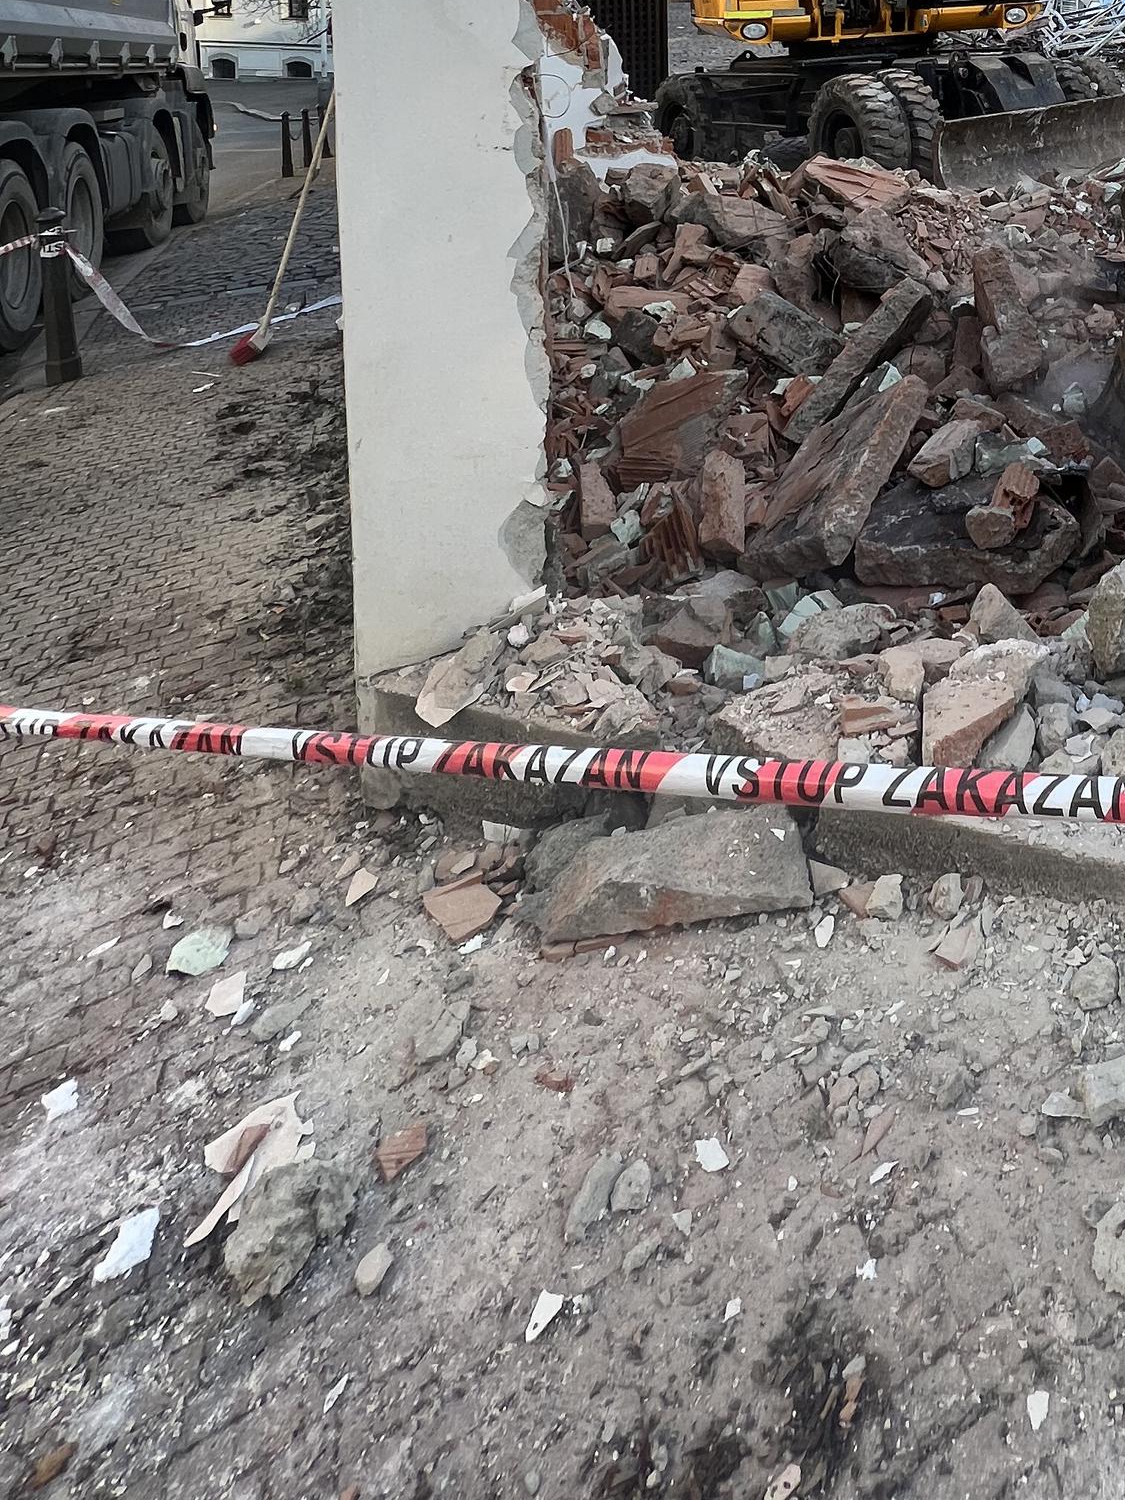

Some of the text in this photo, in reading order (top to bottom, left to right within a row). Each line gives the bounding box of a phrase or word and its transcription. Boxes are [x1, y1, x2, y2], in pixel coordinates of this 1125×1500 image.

[292, 731, 426, 768] VSTUP
[433, 740, 650, 789] ZAKAZAN
[705, 754, 868, 804] VSTUP
